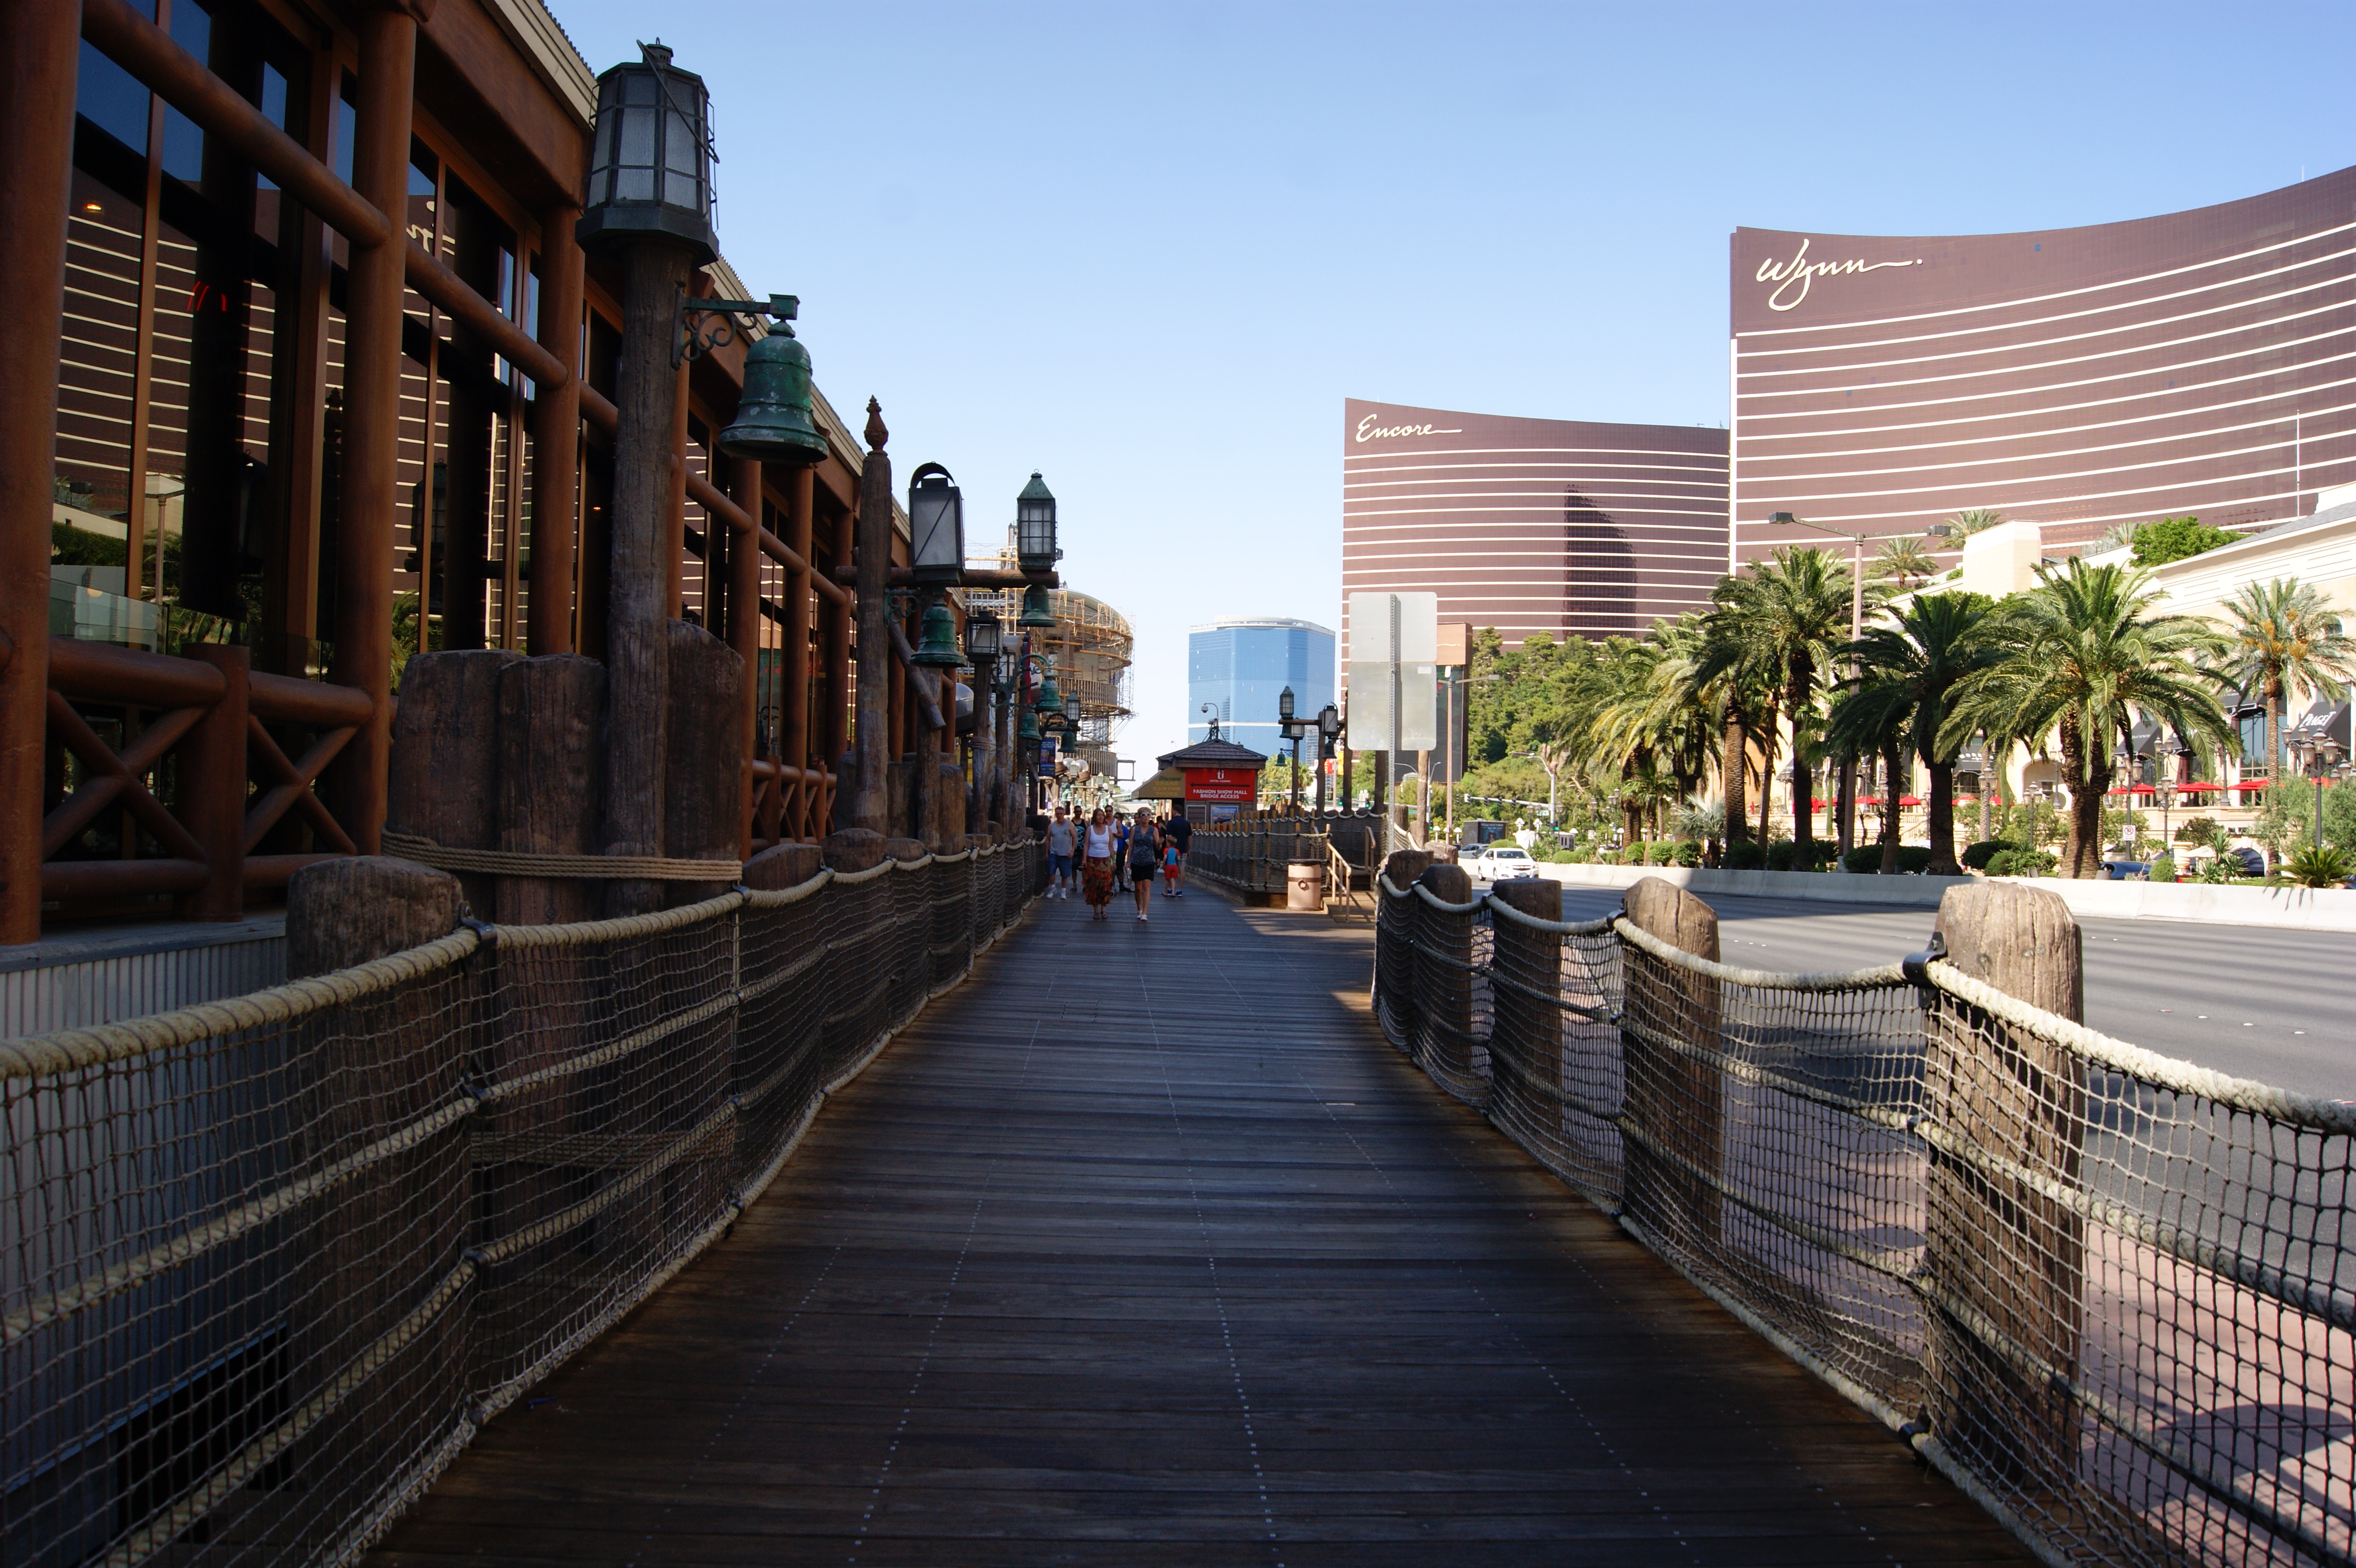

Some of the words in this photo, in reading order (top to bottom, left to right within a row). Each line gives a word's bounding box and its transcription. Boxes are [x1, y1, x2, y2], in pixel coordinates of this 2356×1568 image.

[1356, 414, 1462, 442] Encore
[2299, 711, 2337, 728] PIAGET
[1216, 770, 1224, 779] ti
